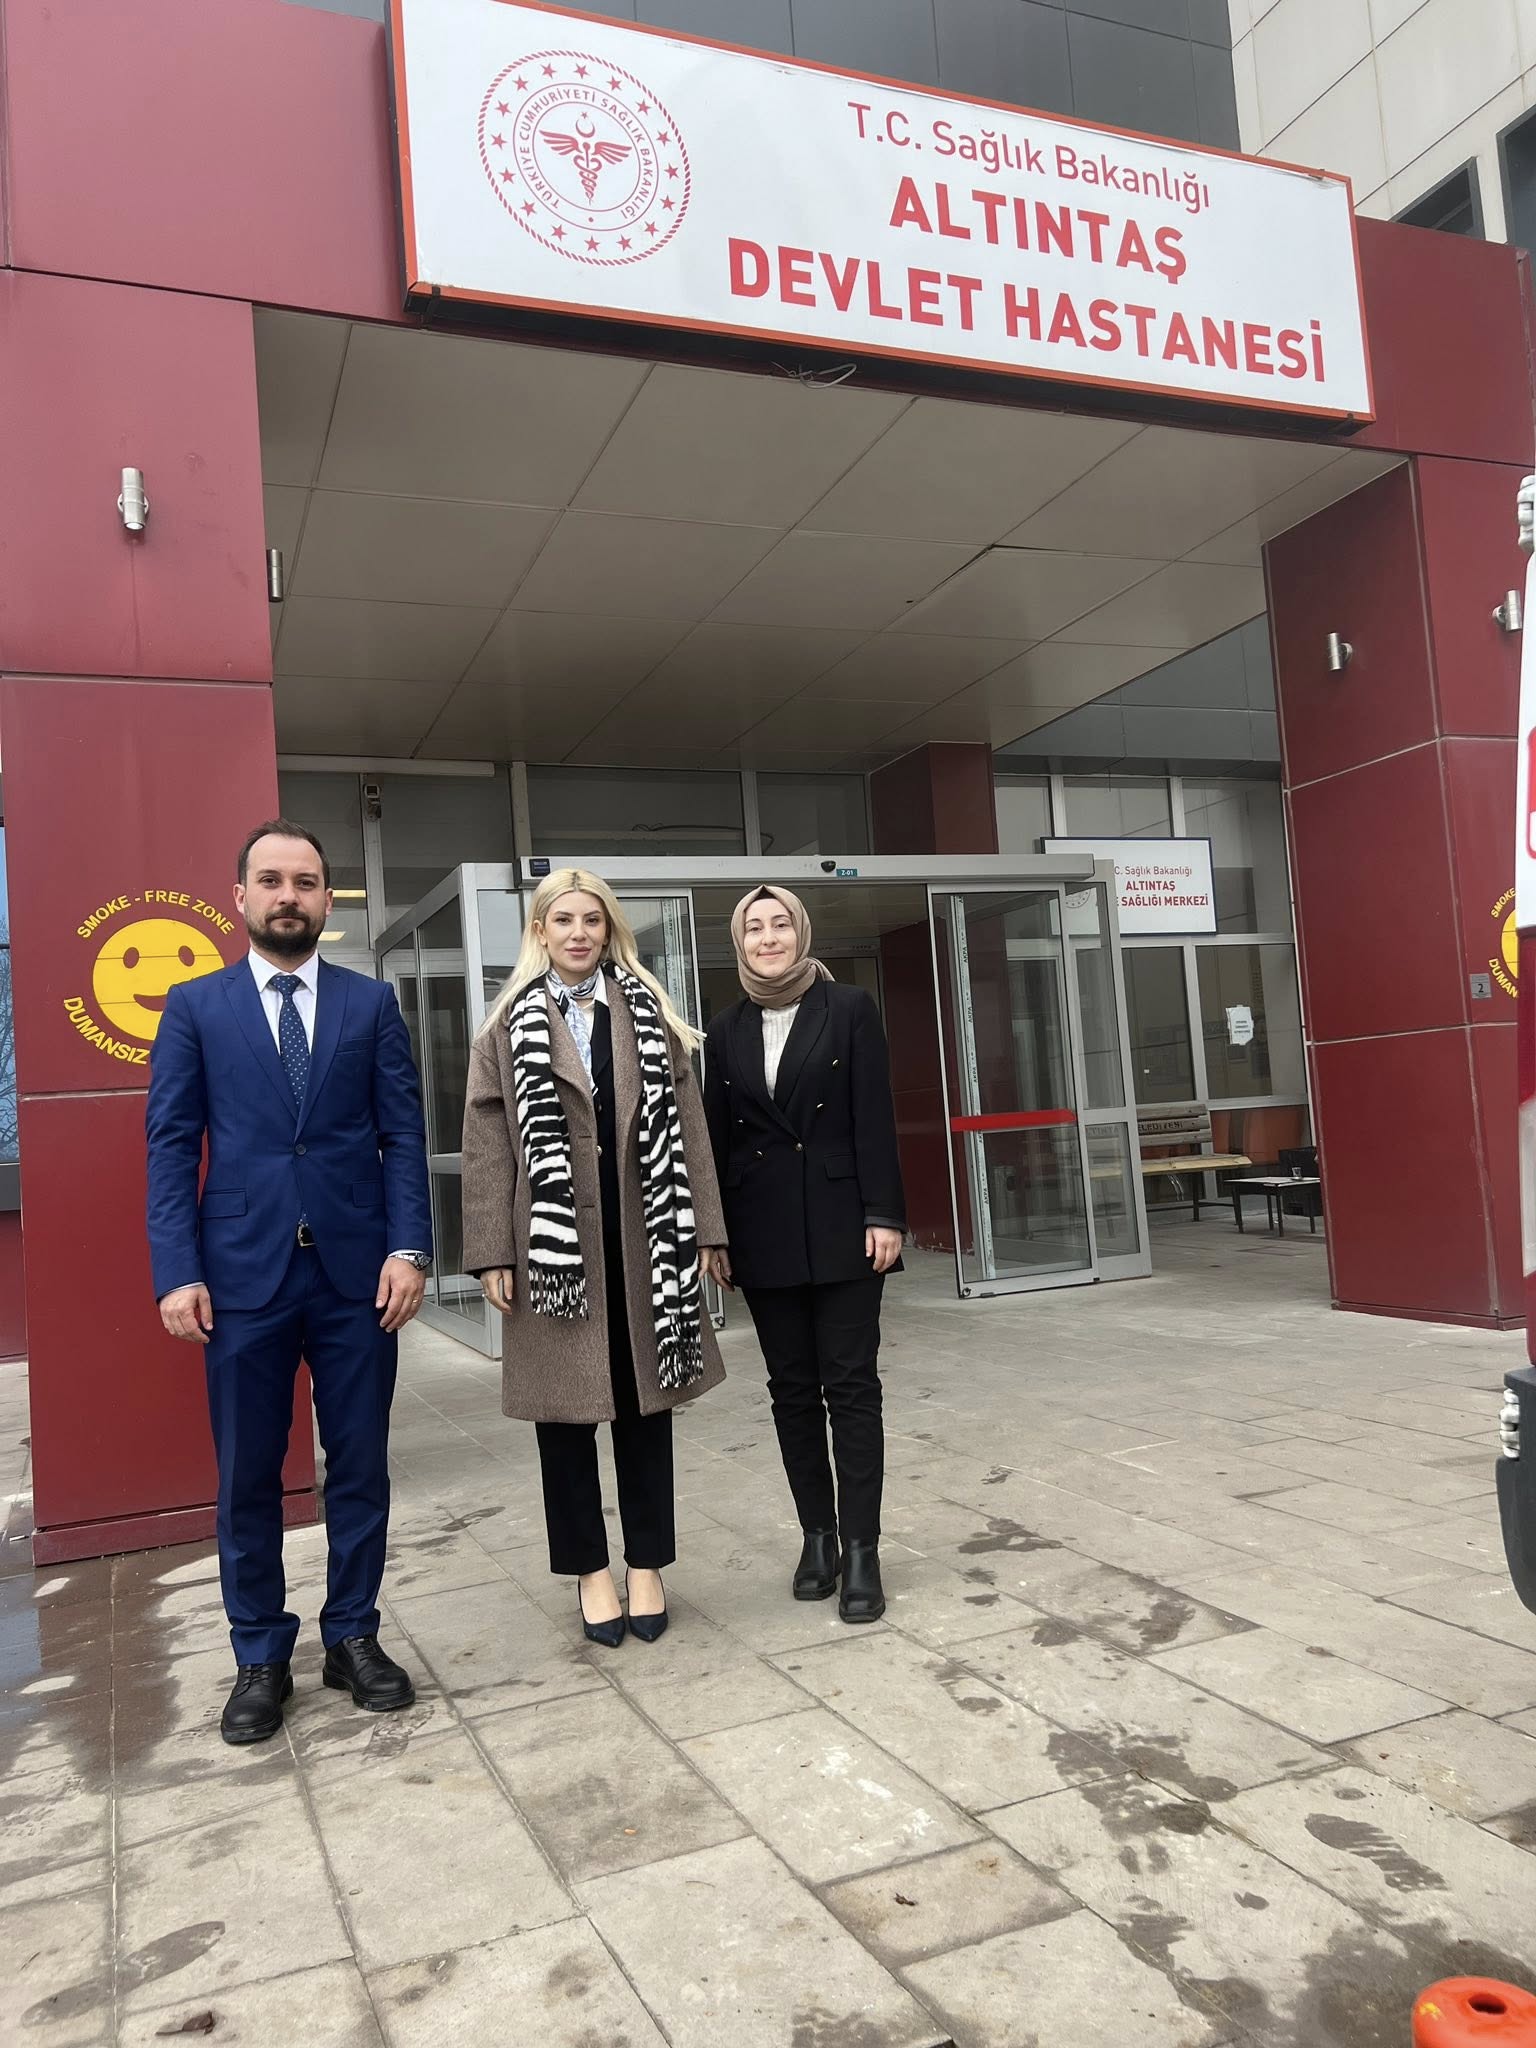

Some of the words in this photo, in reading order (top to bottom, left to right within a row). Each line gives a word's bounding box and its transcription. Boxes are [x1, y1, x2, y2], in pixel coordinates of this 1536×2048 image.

[519, 87, 596, 141] CUMHURİYETİ
[600, 97, 646, 143] SAĞLIK
[520, 146, 560, 209] TÜRKİYE
[847, 101, 922, 150] T.C.
[932, 120, 1046, 175] Sağlık
[1055, 144, 1210, 214] Bakanlığı
[620, 148, 654, 220] BAKANLIĞI
[889, 175, 1188, 285] ALTINTAŞ
[728, 237, 983, 331] DEVLET
[1003, 282, 1326, 383] HASTANESİ
[1114, 865, 1123, 875] C.
[1125, 865, 1151, 877] Sağlık
[1153, 865, 1193, 877] Bakanlığı
[1125, 880, 1176, 892] ALTINTAŞ
[77, 895, 132, 938] SMOKE
[144, 890, 190, 907] FREE
[191, 899, 235, 935] ZONE
[1121, 894, 1162, 906] SAĞLIĞI
[1164, 893, 1209, 906] MERKEZİ
[1490, 887, 1517, 919] SMOKE
[1477, 983, 1484, 992] 2
[1488, 958, 1519, 998] DUMAN
[63, 996, 150, 1065] DUMANSIZ
